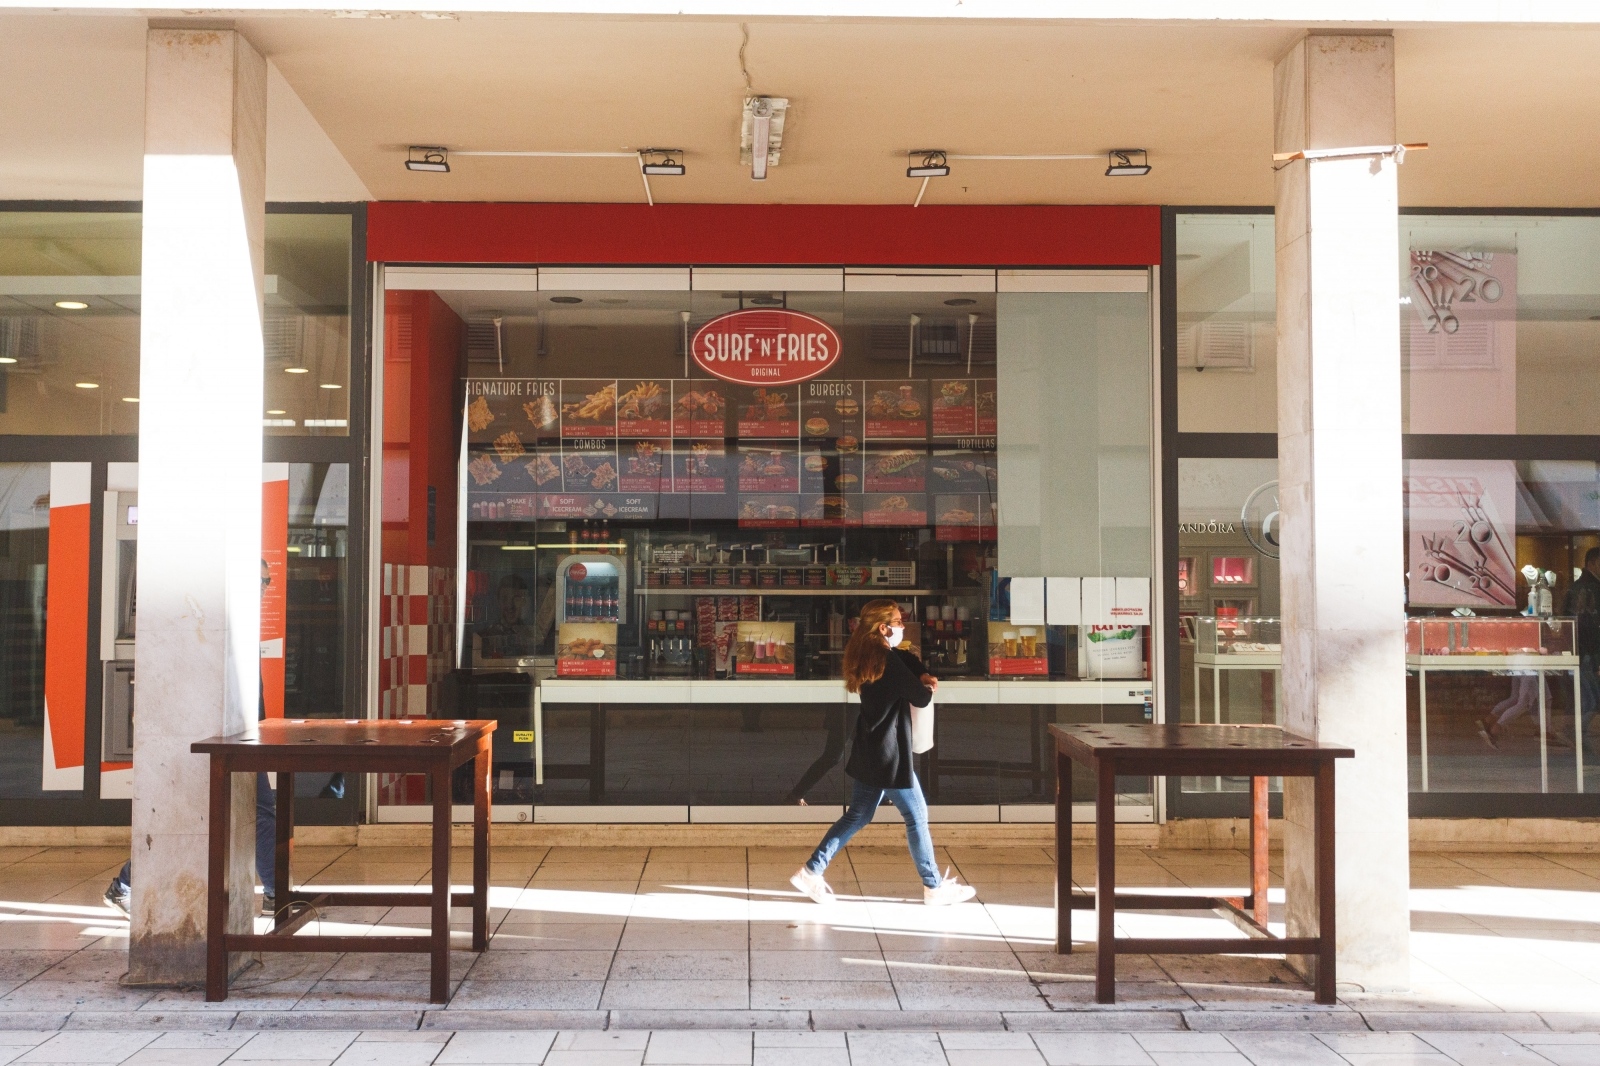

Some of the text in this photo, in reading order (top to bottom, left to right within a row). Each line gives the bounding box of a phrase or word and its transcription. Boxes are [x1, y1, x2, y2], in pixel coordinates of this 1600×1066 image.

[704, 333, 754, 362] SURF
[777, 333, 829, 362] FRIES
[751, 368, 781, 377] ORIGINAL
[465, 382, 555, 396] SIGNATURE FRIES
[810, 383, 853, 396] BURGERS
[574, 439, 606, 450] COMBOS
[957, 439, 995, 449] TORTILLAS
